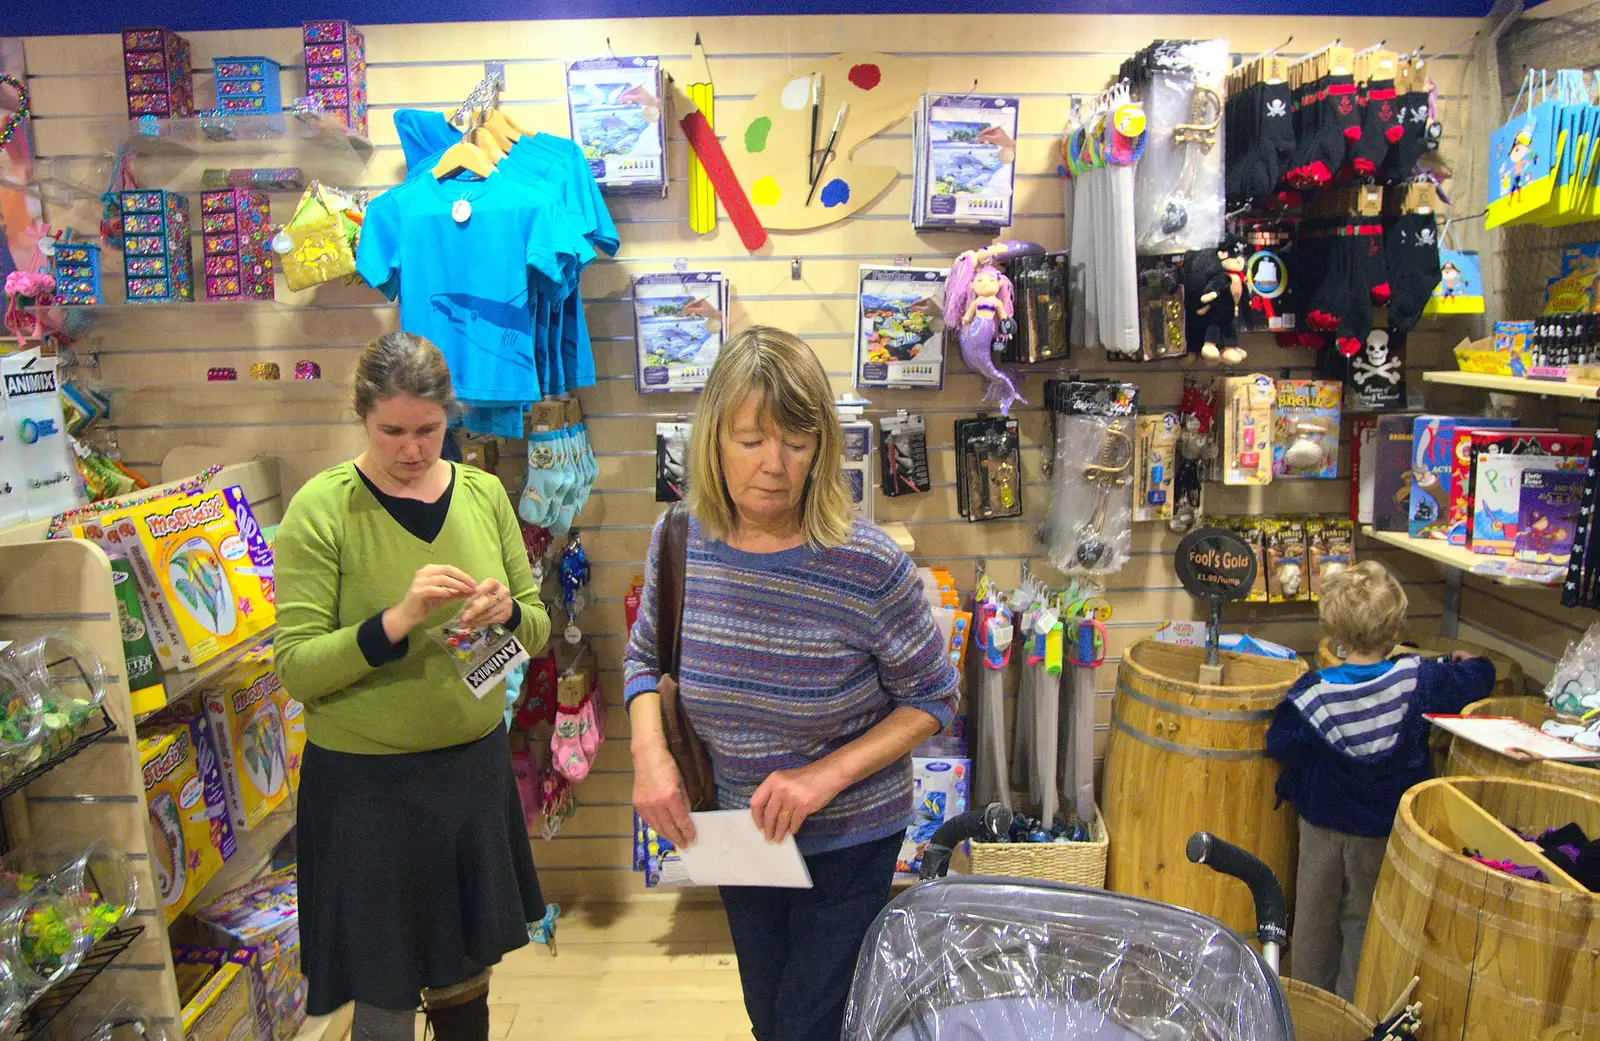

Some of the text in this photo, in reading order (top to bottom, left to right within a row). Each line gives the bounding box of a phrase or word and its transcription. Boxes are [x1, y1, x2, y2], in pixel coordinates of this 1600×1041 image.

[8, 373, 54, 394] ANIMIX
[1485, 469, 1517, 492] Pir
[1189, 549, 1249, 569] Fool's Gold
[470, 642, 518, 686] ANIMIX
